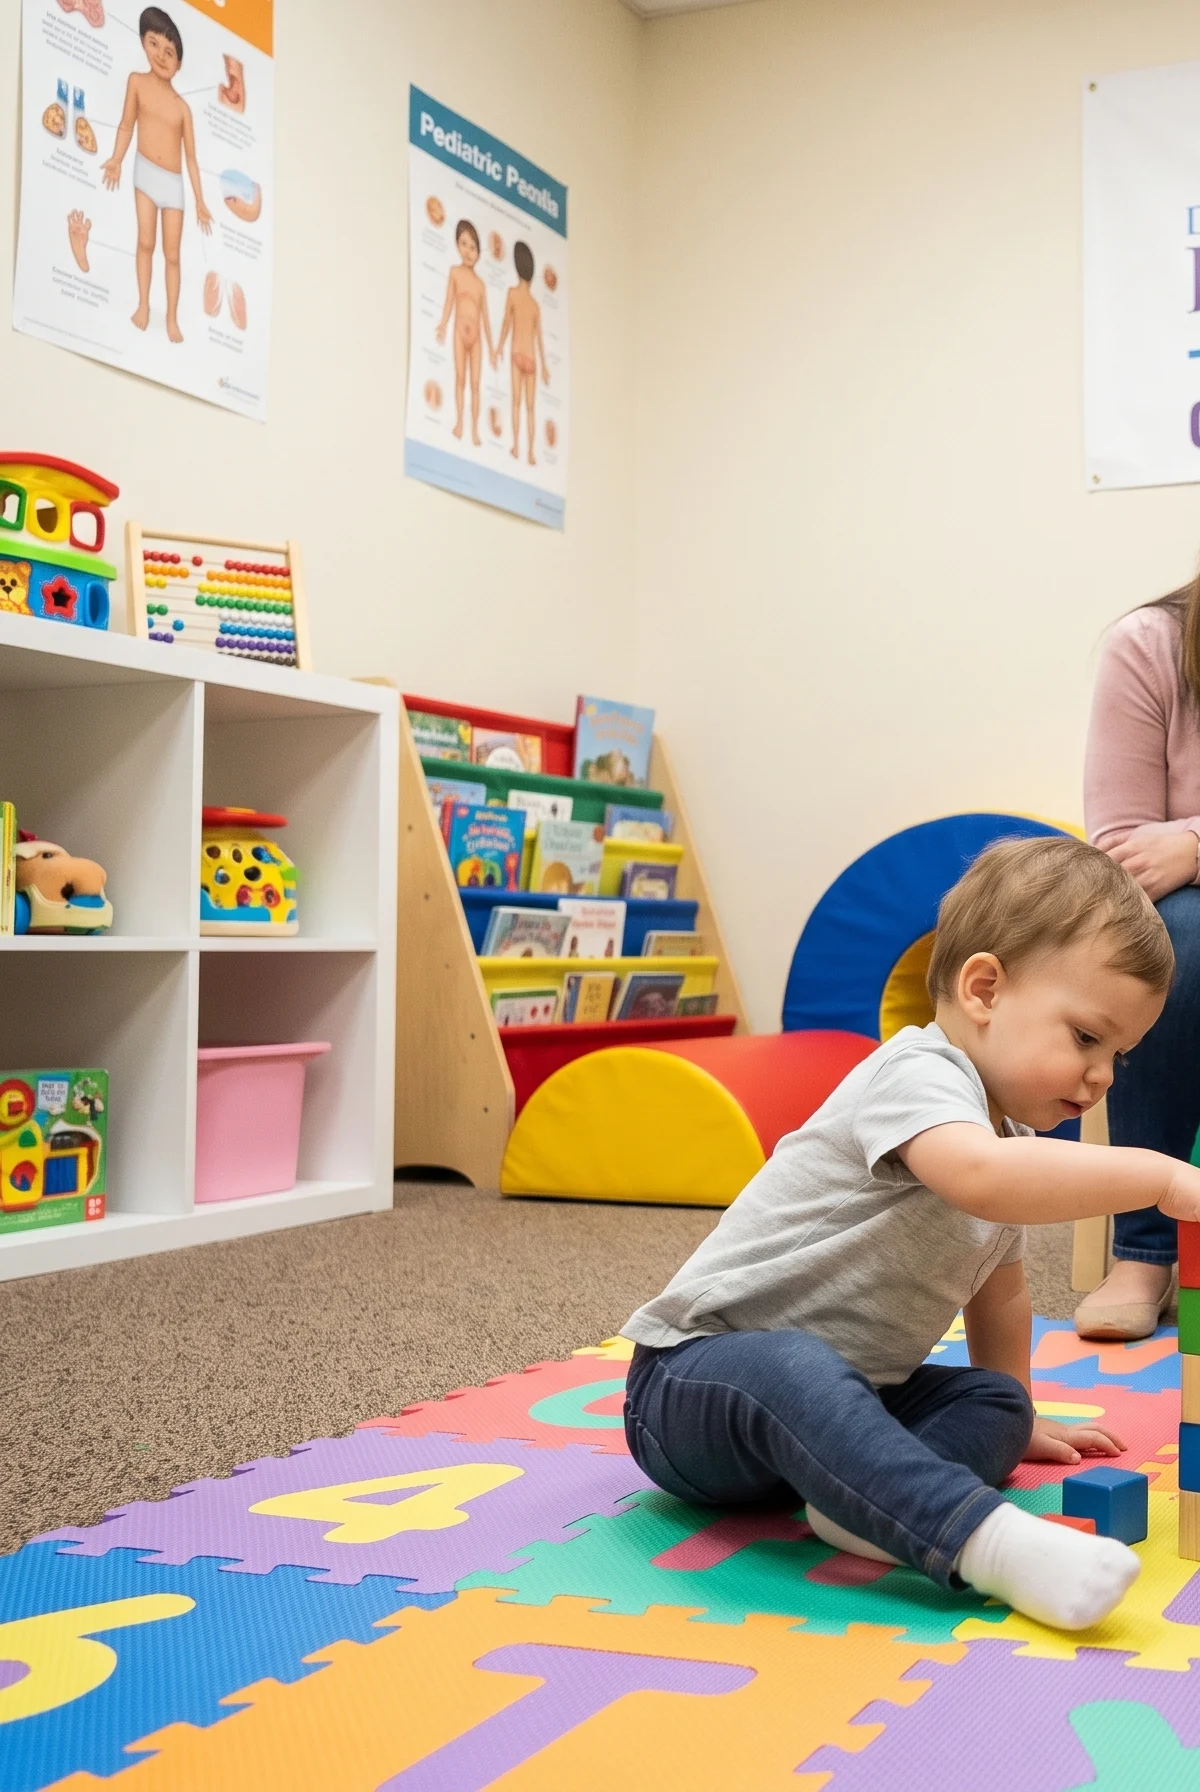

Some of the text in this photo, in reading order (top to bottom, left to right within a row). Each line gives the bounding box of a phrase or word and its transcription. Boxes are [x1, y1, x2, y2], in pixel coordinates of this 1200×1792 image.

[419, 111, 503, 182] Pediatric
[248, 1462, 526, 1544] 4
[373, 1642, 759, 1792] T
